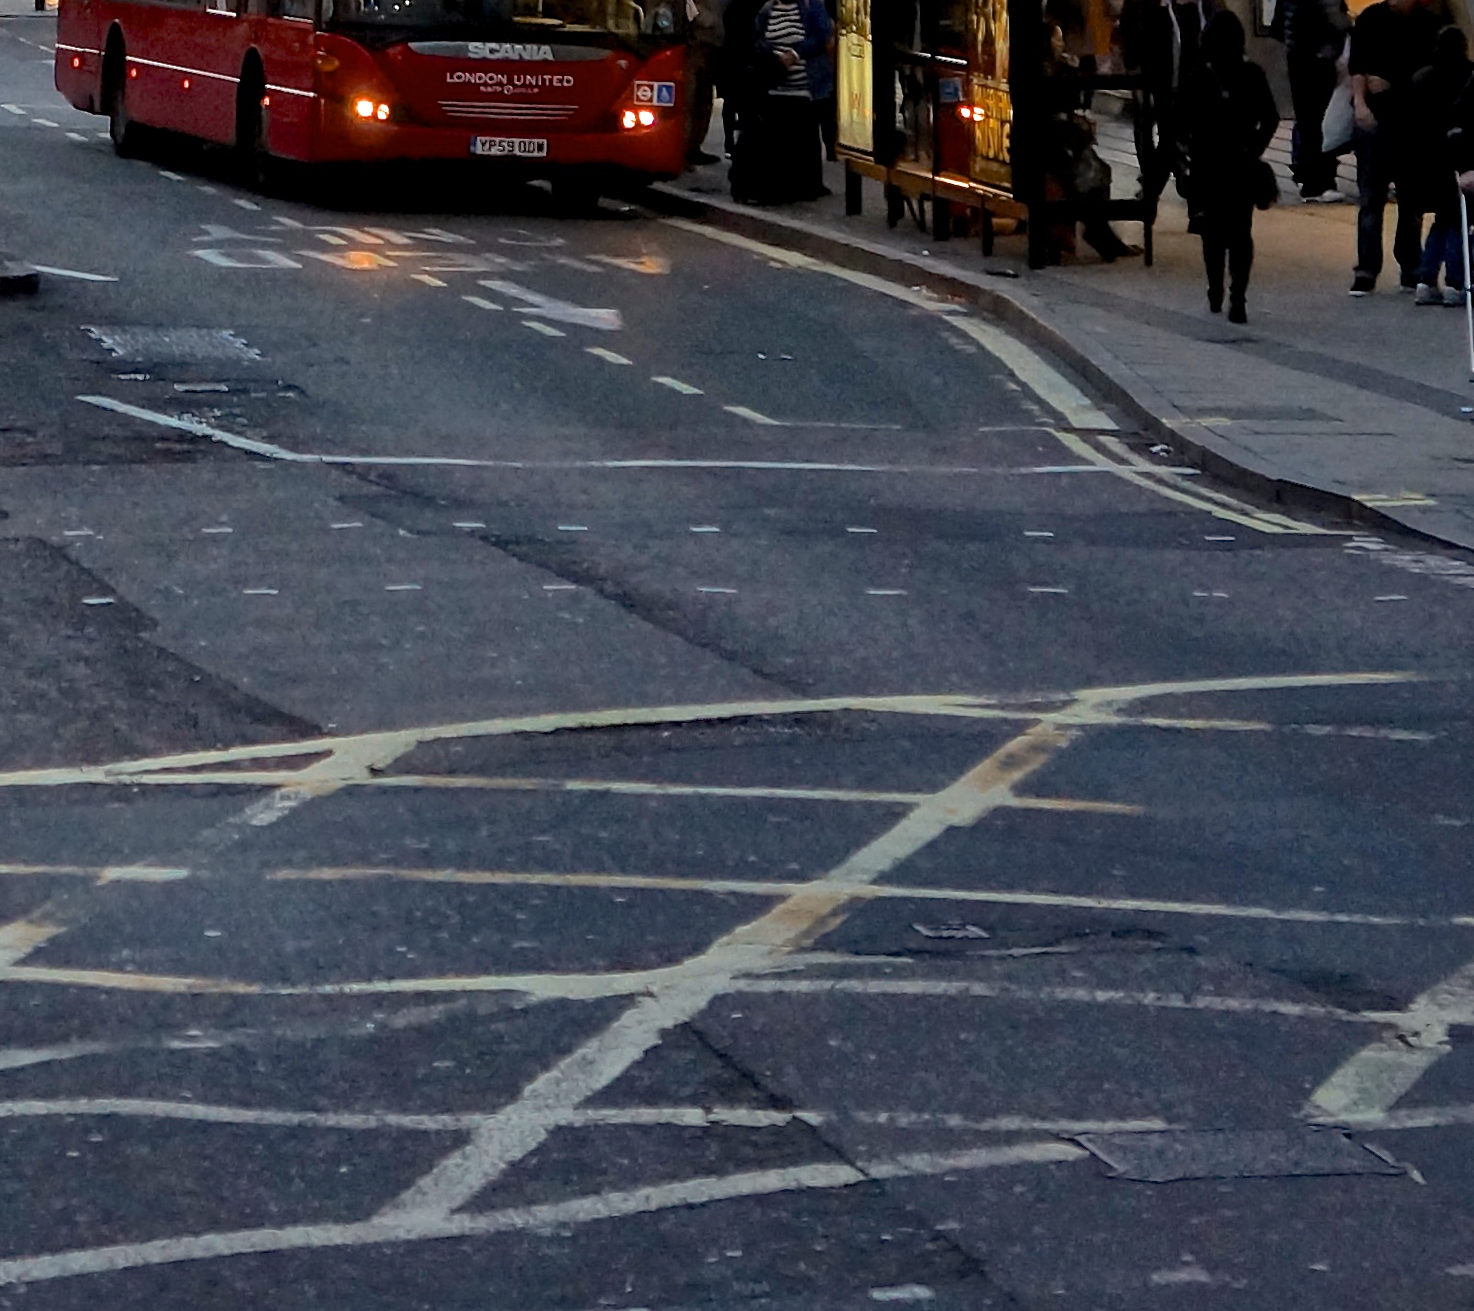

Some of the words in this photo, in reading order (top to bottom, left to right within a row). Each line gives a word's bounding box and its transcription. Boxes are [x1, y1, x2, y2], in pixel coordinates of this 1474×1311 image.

[467, 41, 554, 61] SCANIA
[446, 71, 508, 85] LONDON
[513, 74, 574, 87] UNITED
[479, 138, 515, 153] YP59
